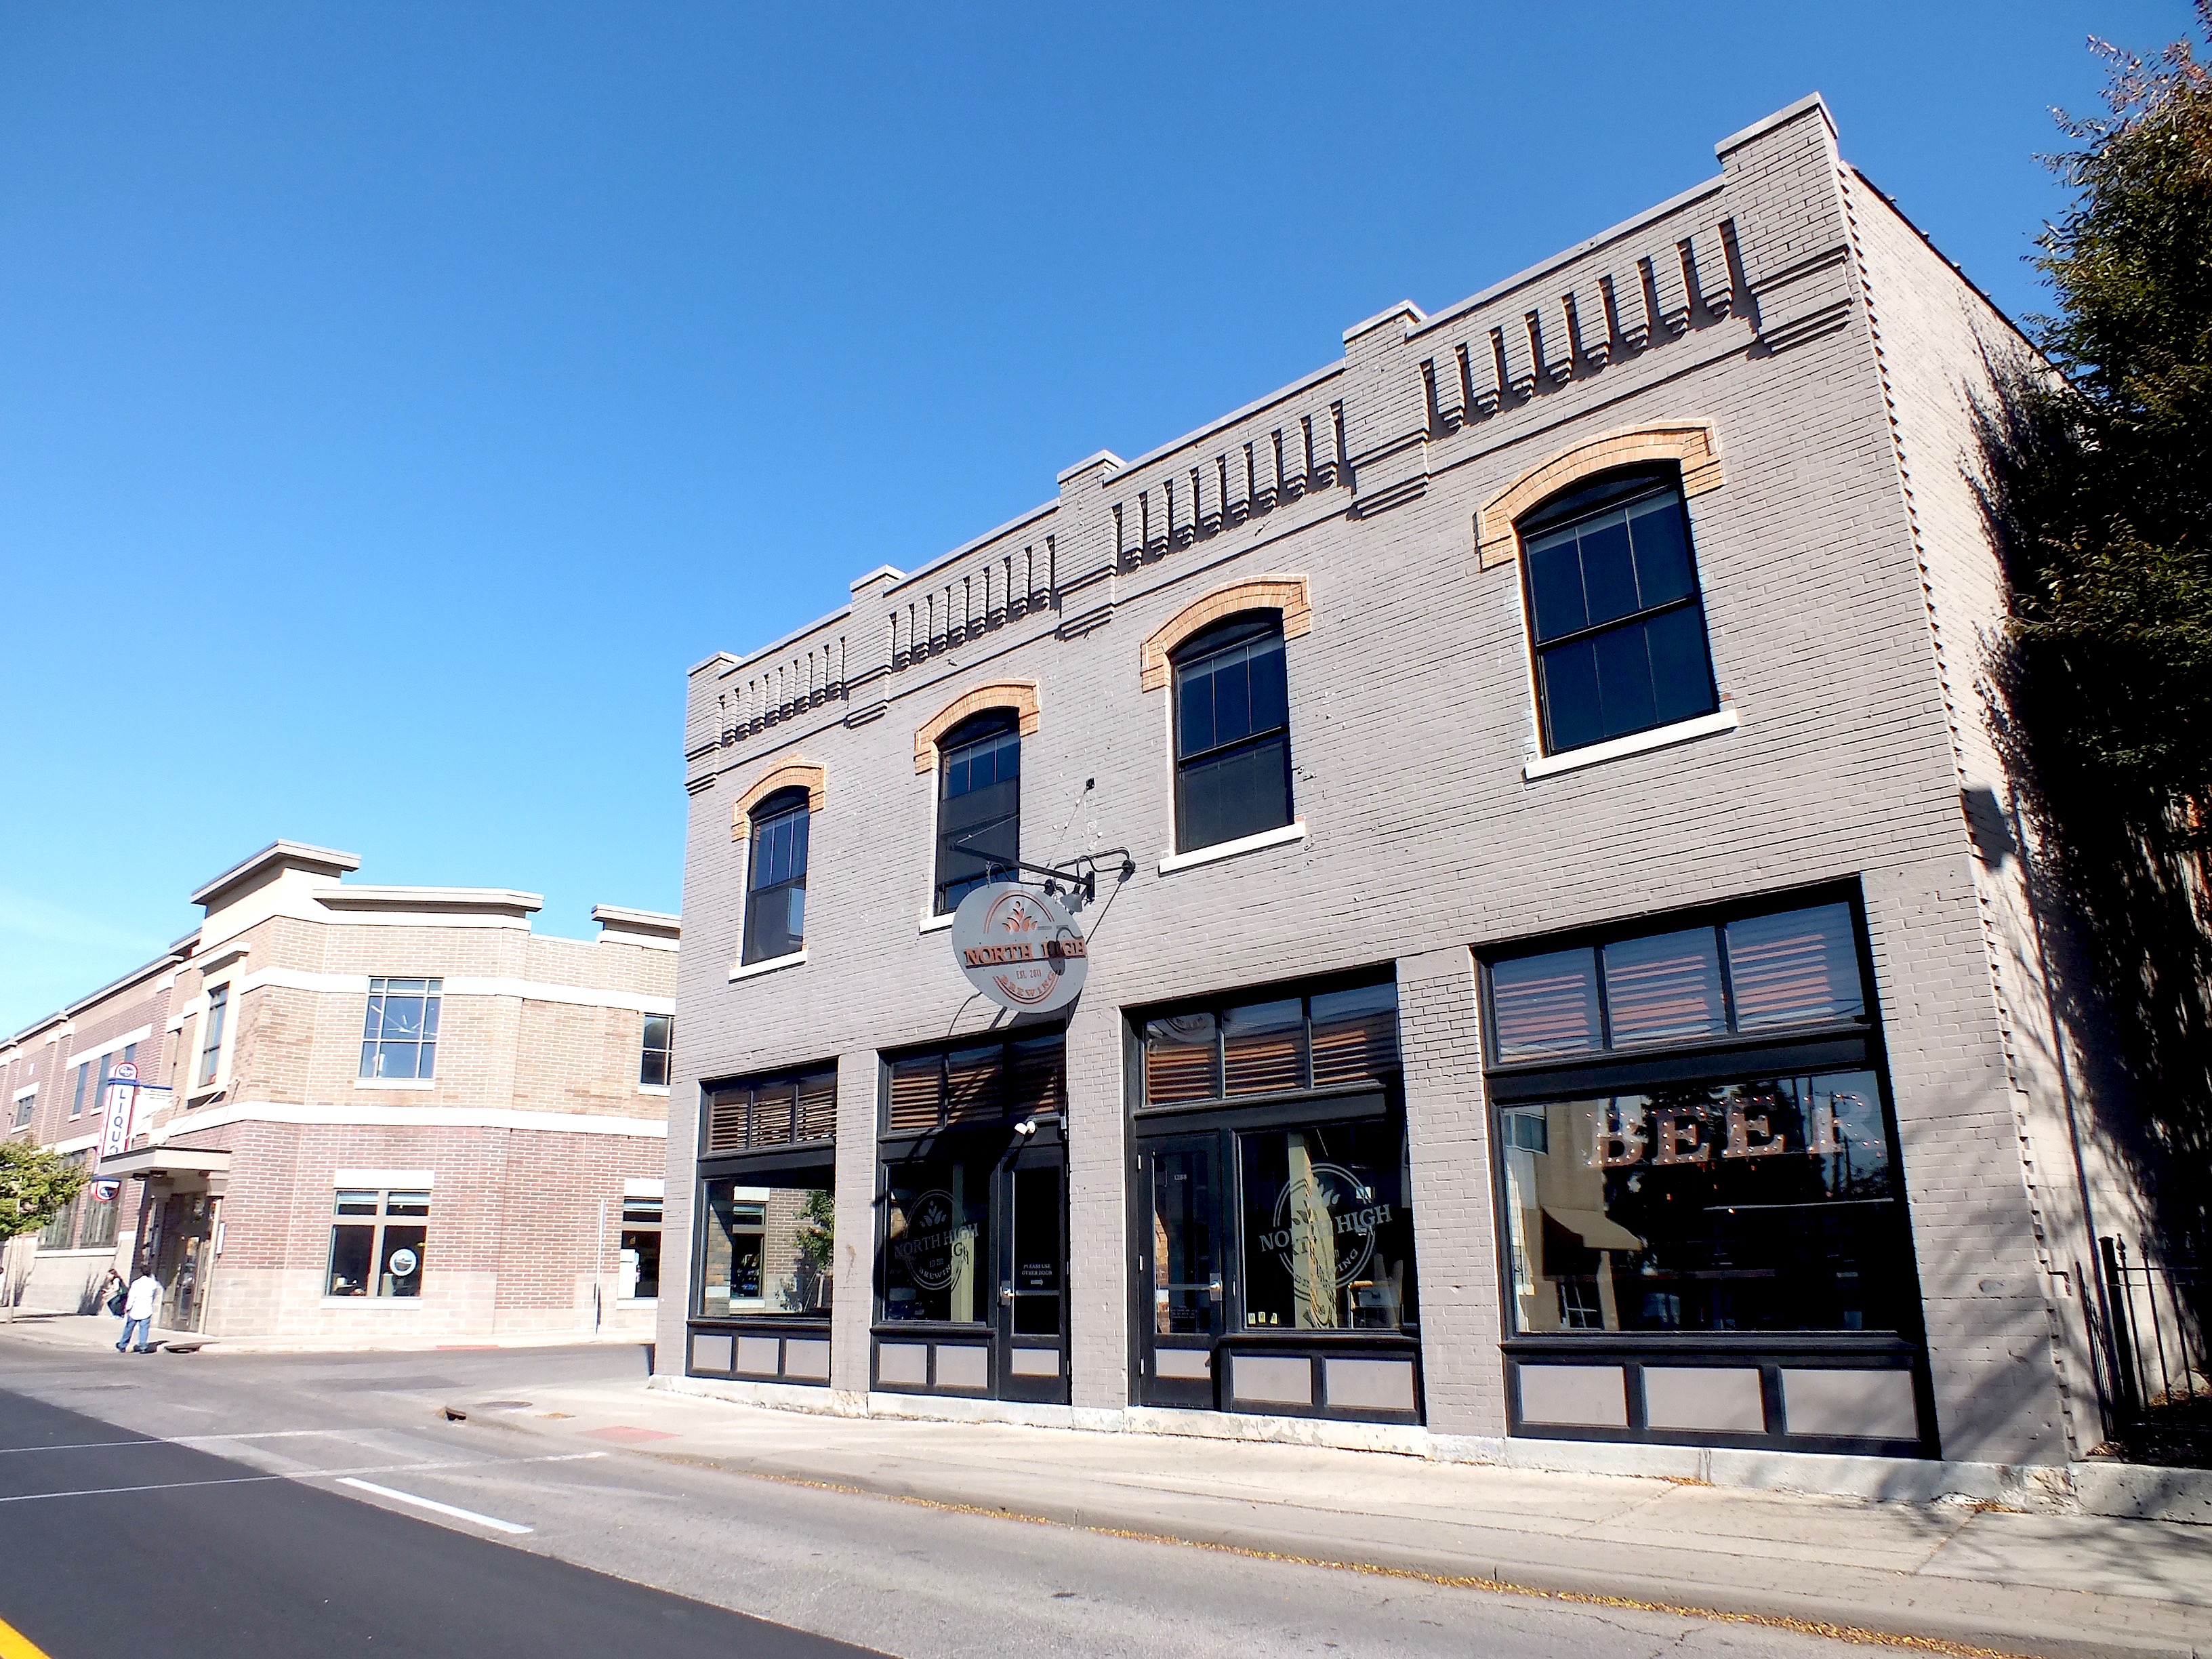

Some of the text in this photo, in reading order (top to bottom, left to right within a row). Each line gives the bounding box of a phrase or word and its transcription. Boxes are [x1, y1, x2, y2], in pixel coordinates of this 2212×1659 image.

[964, 942, 1033, 966] NORTH
[999, 970, 1055, 997] BREWING
[1582, 1090, 1883, 1168] BEER
[1334, 1204, 1393, 1234] HIGH
[894, 1233, 941, 1260] NORTH
[943, 1223, 979, 1246] HIGH
